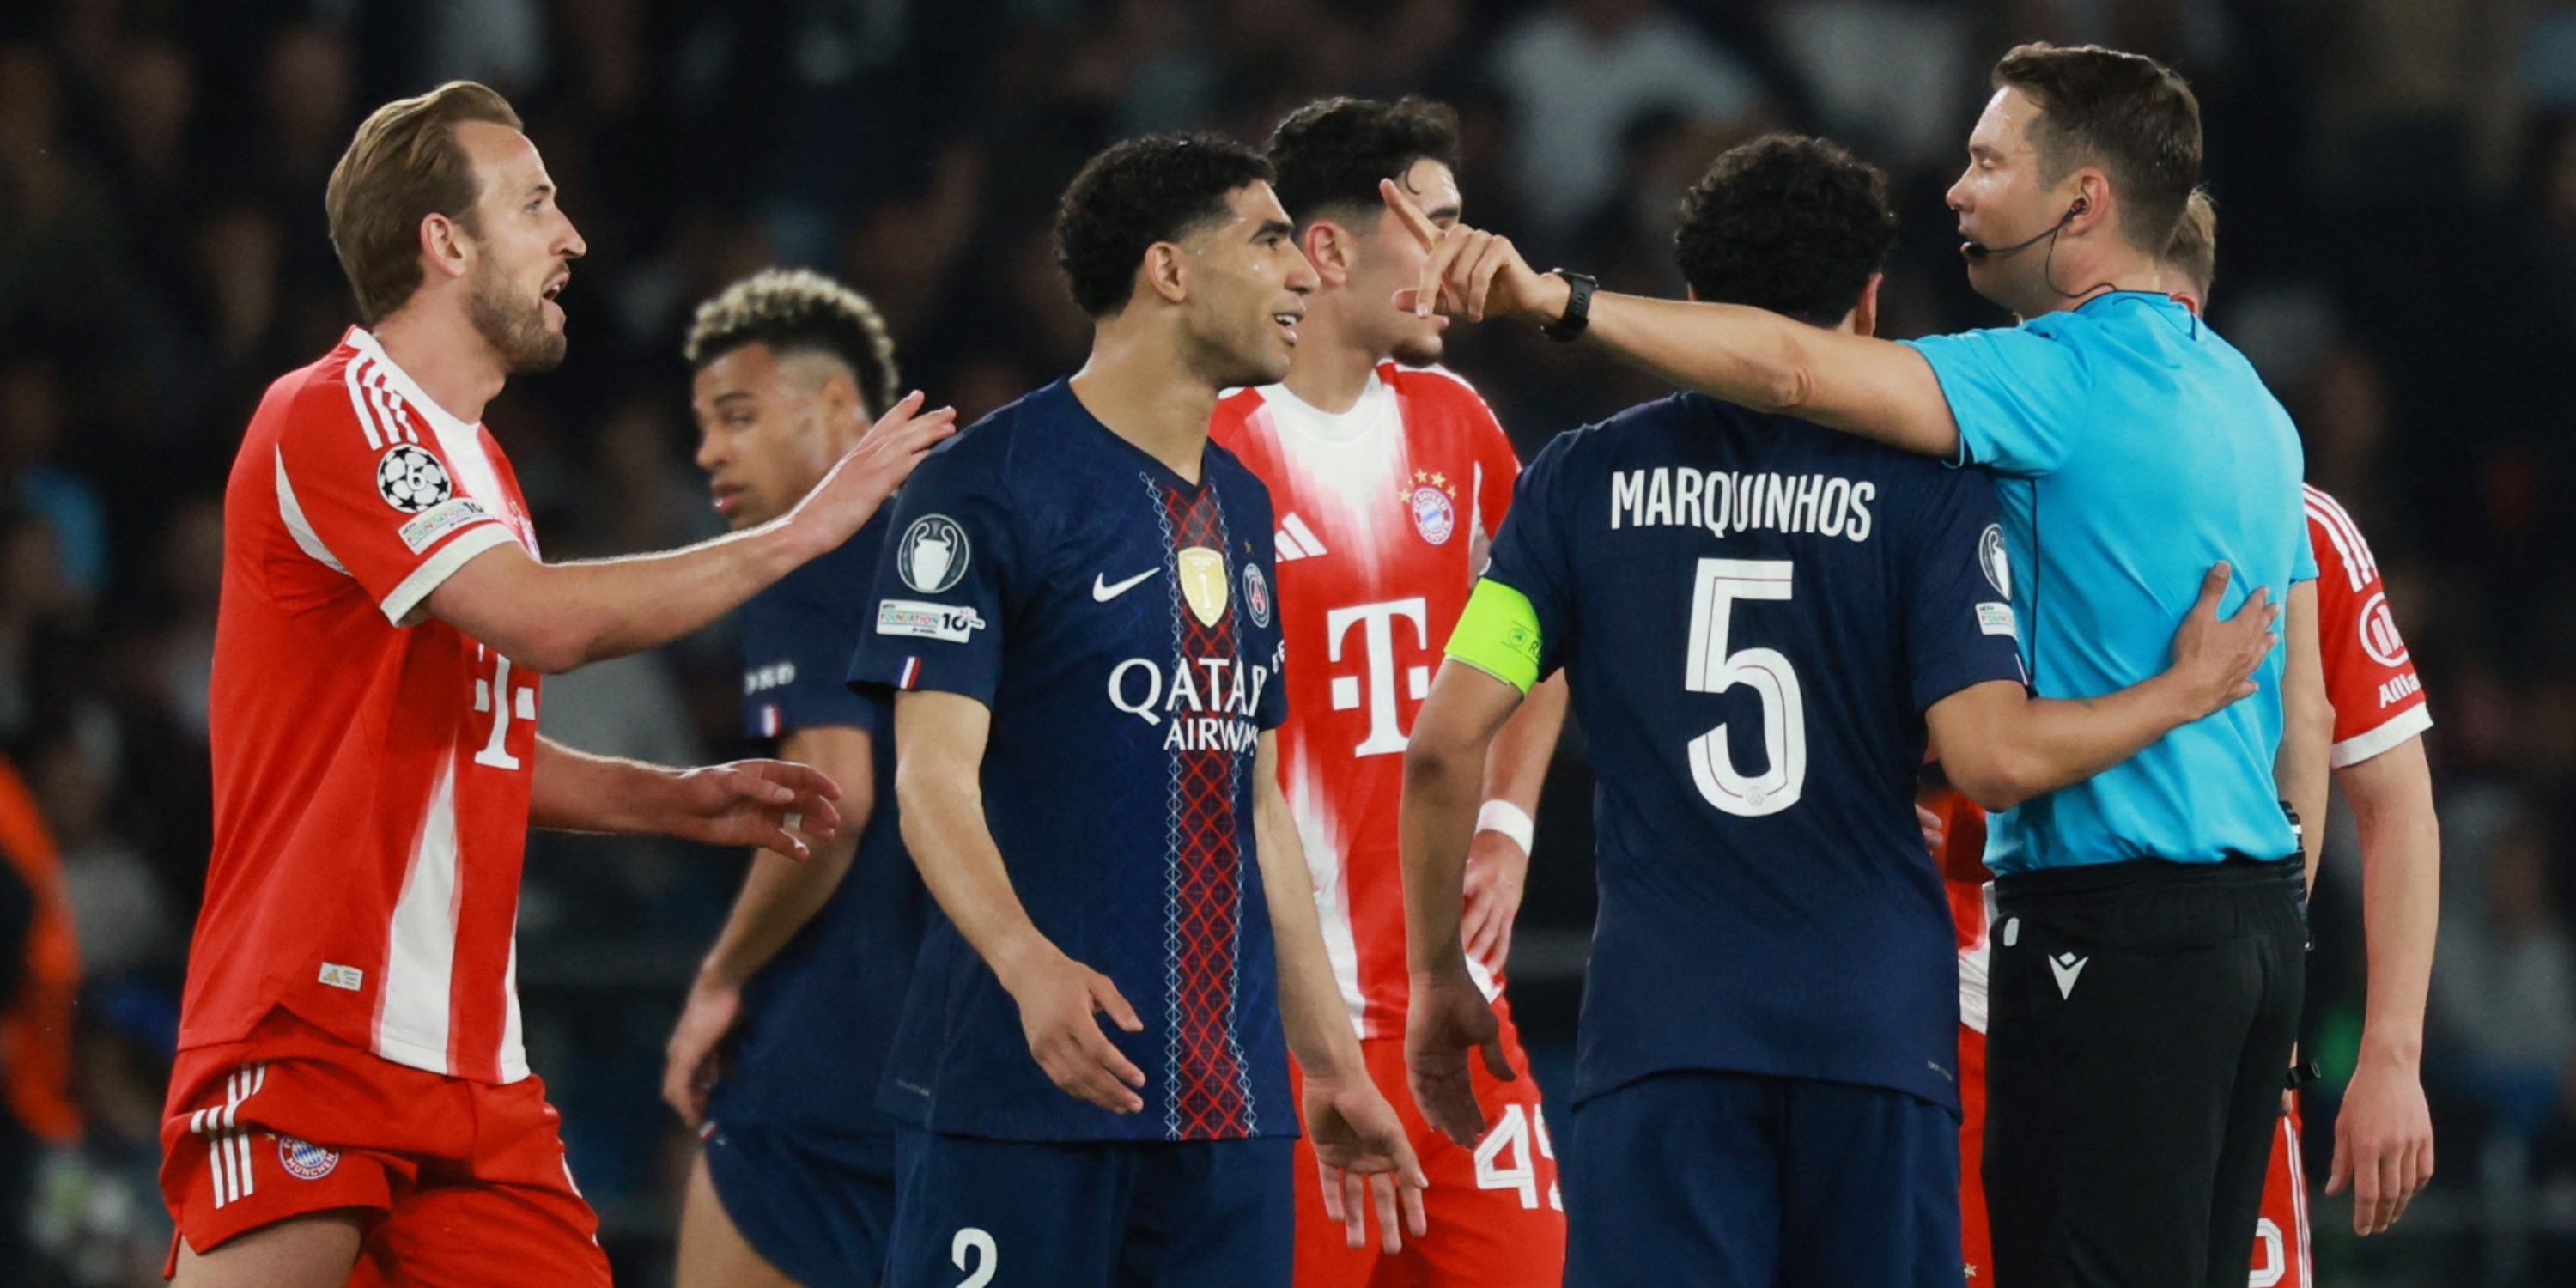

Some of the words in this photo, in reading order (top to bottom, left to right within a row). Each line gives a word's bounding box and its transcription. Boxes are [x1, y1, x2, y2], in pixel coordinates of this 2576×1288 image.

[406, 465, 428, 492] 6
[1610, 466, 1877, 543] MARQUINHOS
[943, 612, 969, 632] 10
[1327, 596, 1430, 758] T
[1685, 557, 1807, 817] 5
[951, 1226, 998, 1288] 2
